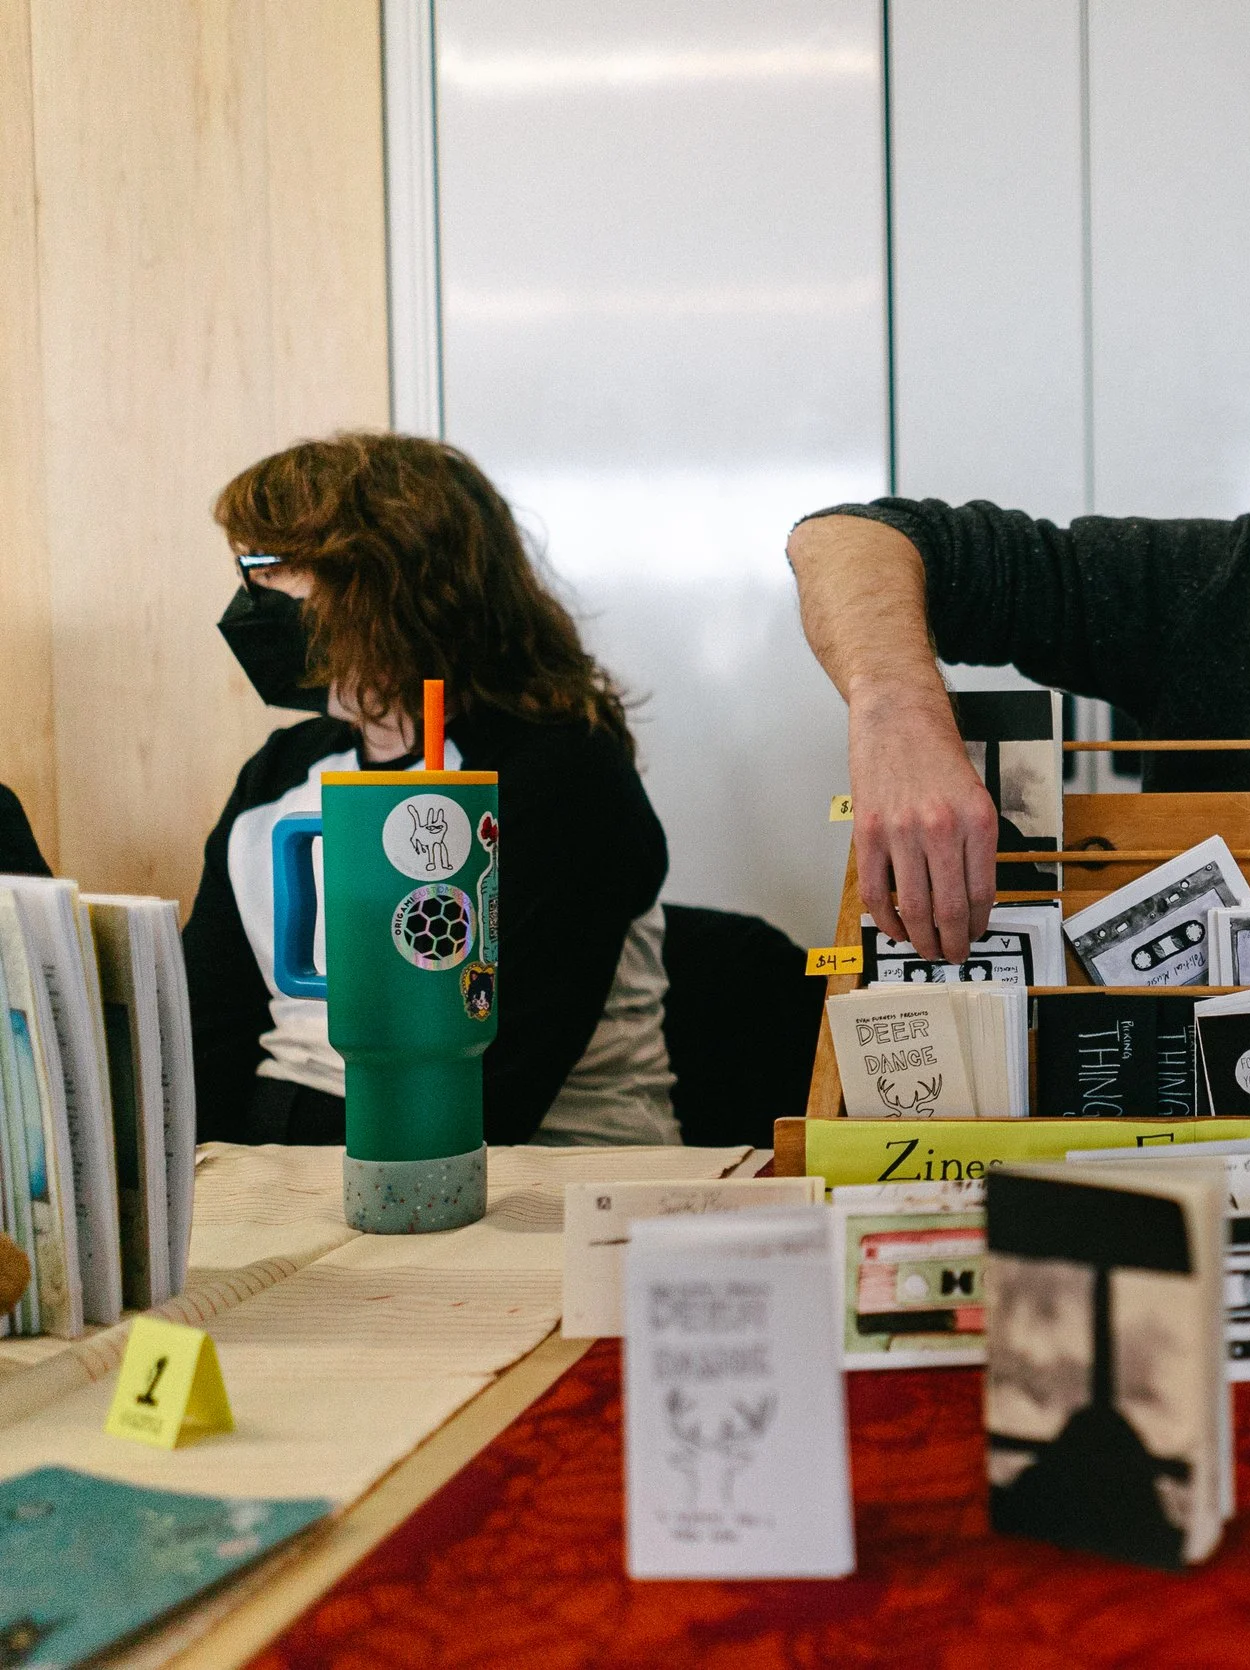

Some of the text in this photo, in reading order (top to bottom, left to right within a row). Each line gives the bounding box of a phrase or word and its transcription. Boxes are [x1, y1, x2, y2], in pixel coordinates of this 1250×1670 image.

[1000, 938, 1011, 949] A
[816, 955, 836, 970] $4
[1173, 952, 1206, 976] Political
[855, 1018, 929, 1046] DEER
[1121, 1020, 1134, 1060] PICKING
[864, 1045, 937, 1075] DANCE
